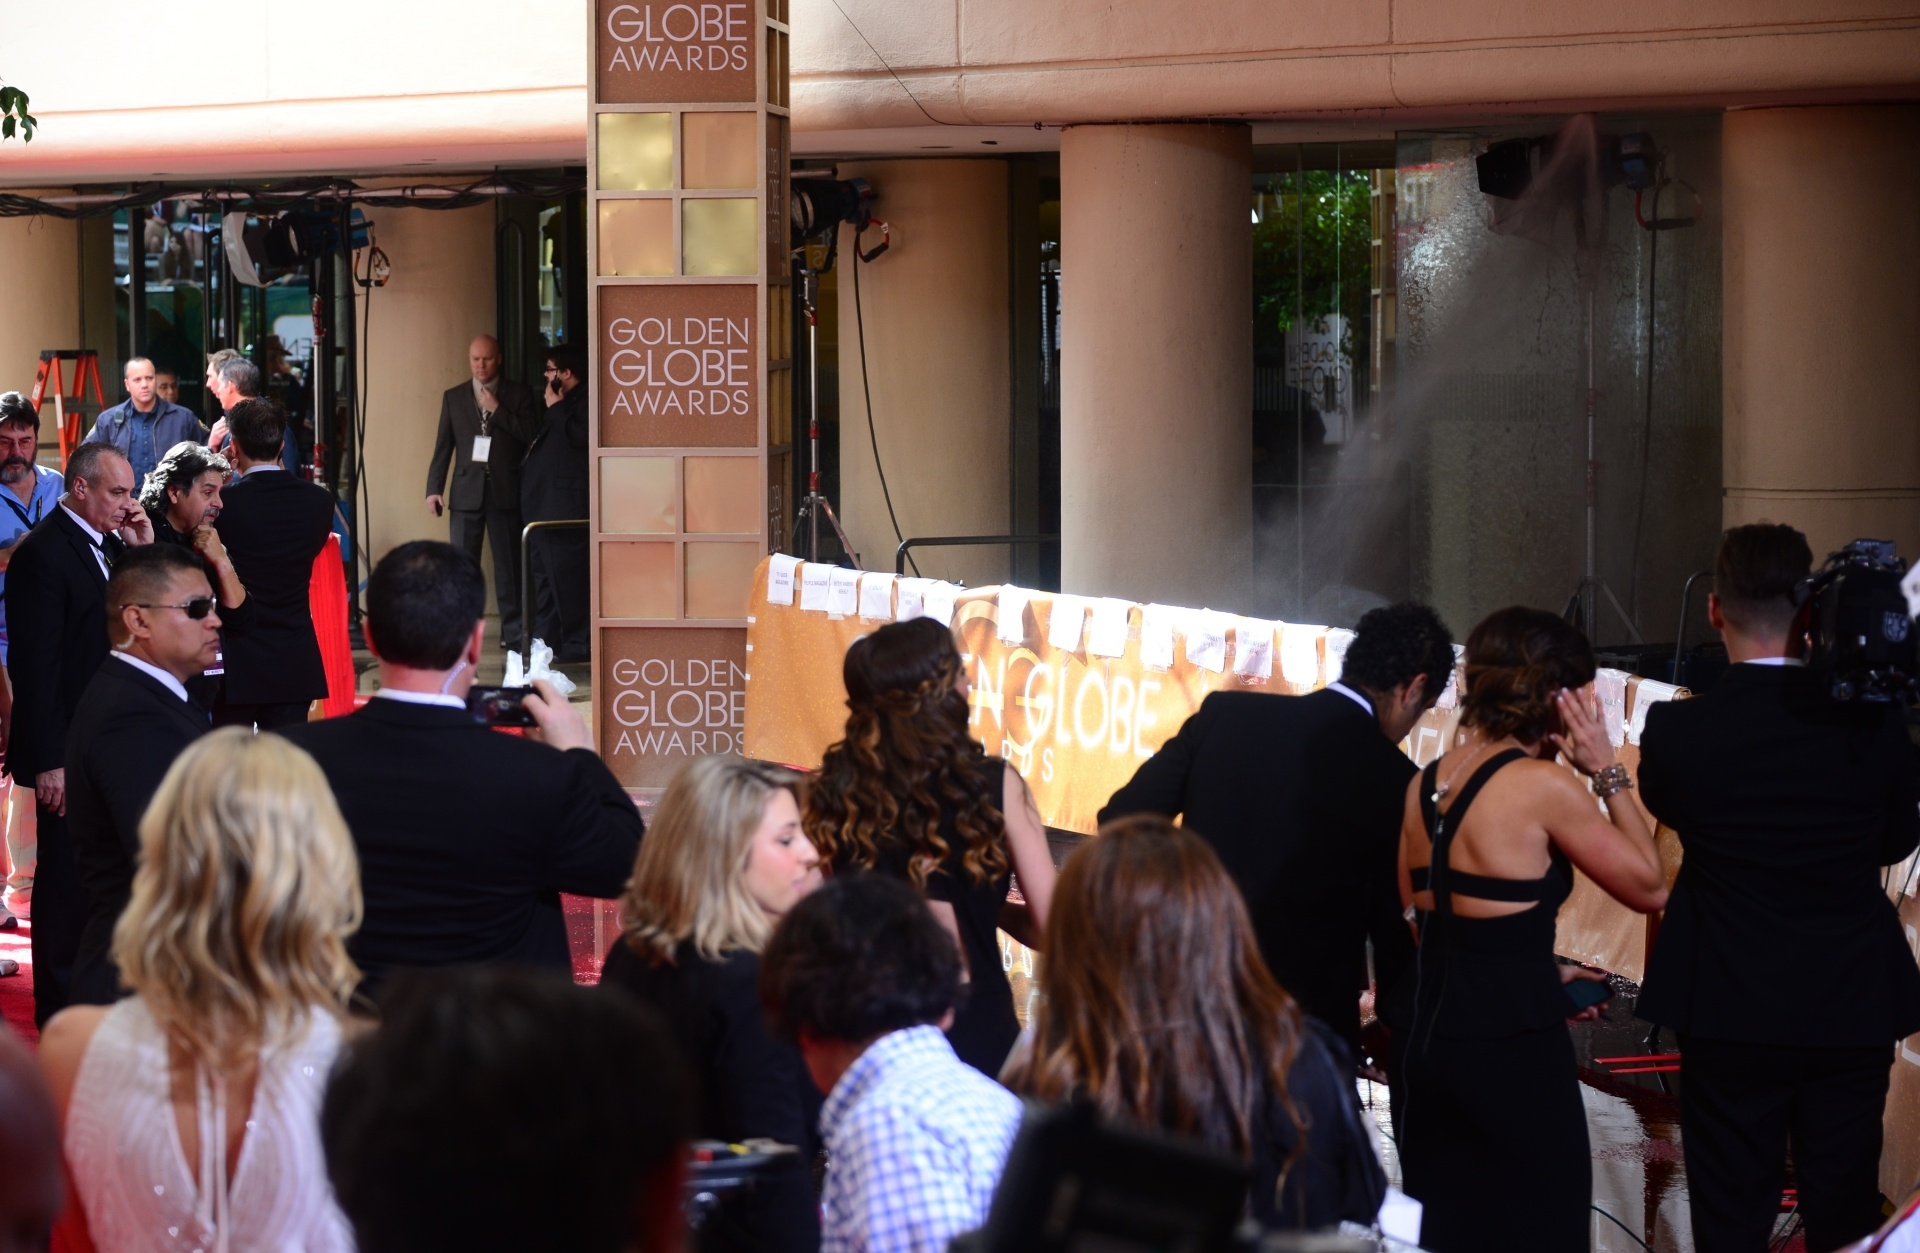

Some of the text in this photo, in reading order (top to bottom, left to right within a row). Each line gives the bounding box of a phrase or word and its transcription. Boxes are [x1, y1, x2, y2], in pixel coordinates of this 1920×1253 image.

[607, 4, 748, 42] GLOBE
[608, 45, 748, 71] AWARDS
[609, 317, 749, 345] GOLDEN
[609, 349, 749, 387] GLOBE
[610, 389, 749, 416] AWARDS
[612, 658, 747, 686] GOLDEN
[612, 689, 745, 727] GLOBE
[1024, 662, 1162, 758] GLOBE
